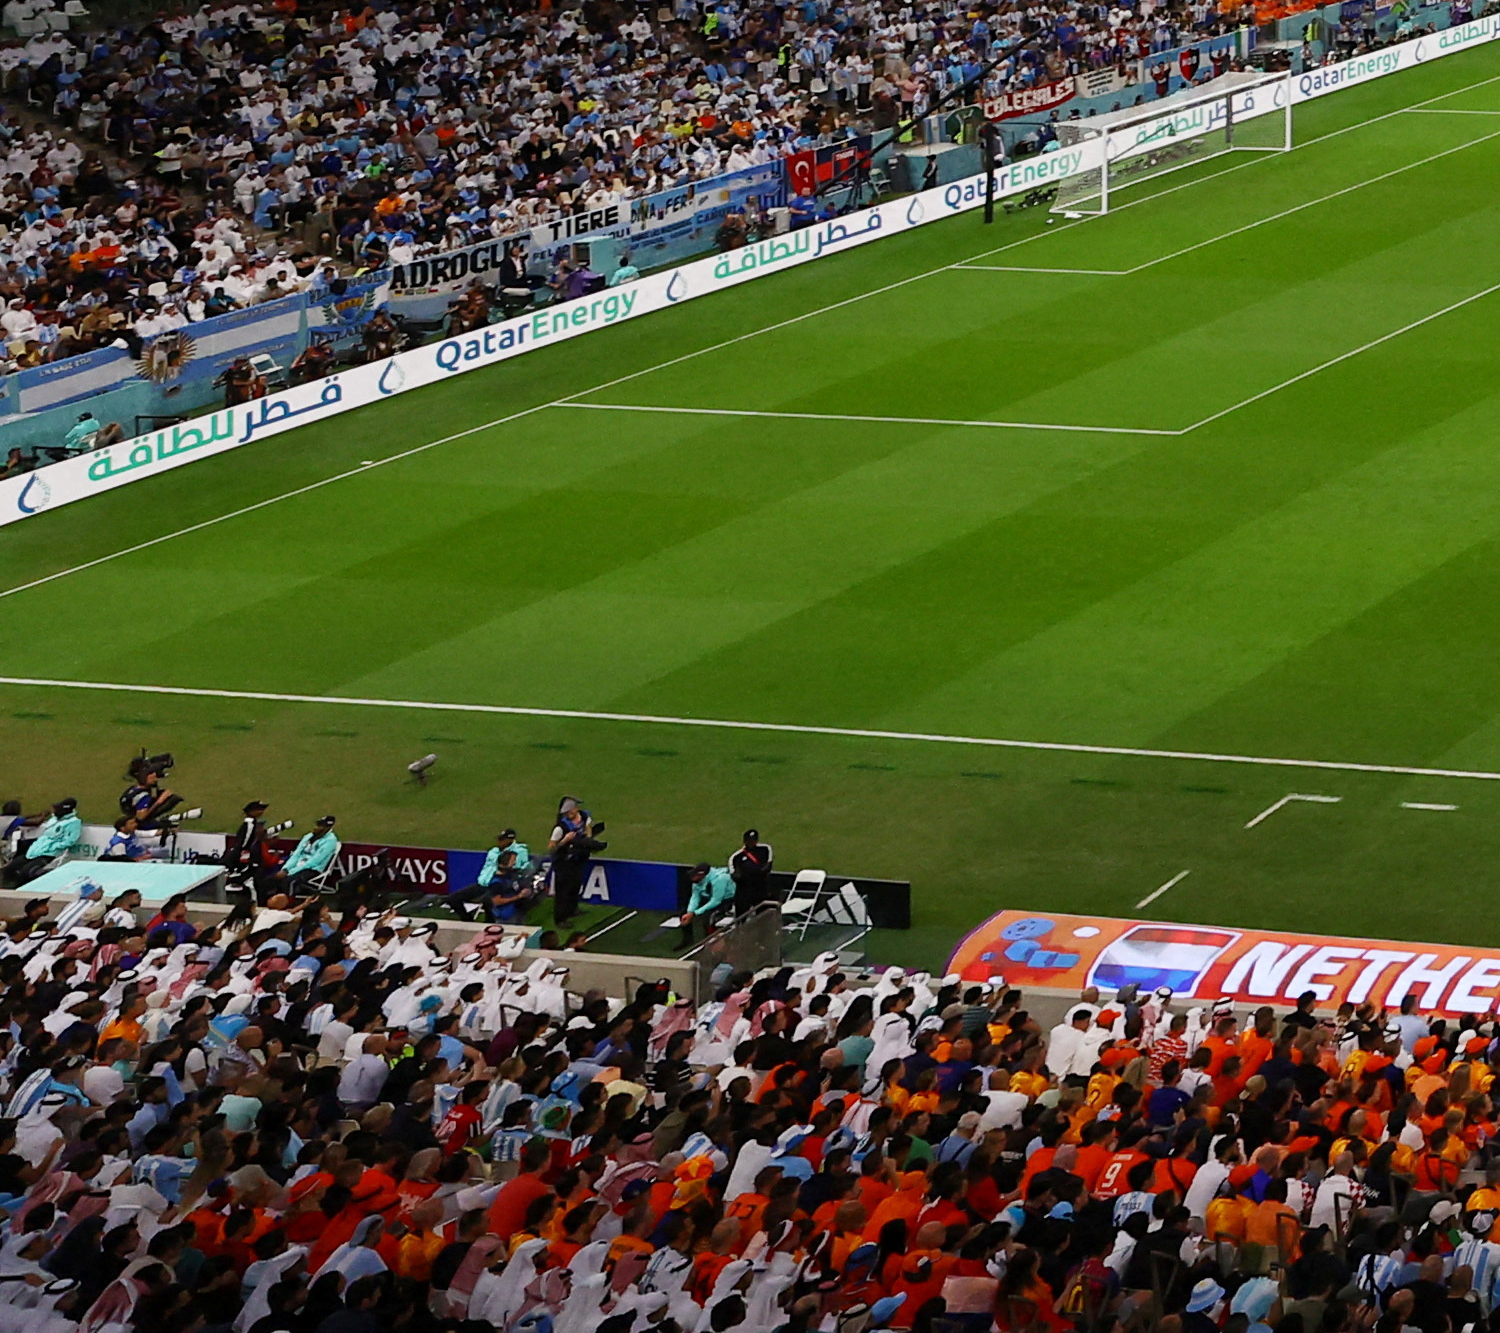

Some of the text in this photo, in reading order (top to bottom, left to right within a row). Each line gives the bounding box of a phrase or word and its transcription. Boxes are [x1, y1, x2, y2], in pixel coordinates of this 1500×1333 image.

[1439, 16, 1489, 48] للطاقة
[1300, 52, 1399, 96] QatarEnergy
[548, 205, 620, 241] TIGRE
[813, 208, 881, 257] قطر
[714, 230, 809, 279] للطاقة
[436, 290, 637, 372] QatarEnergy
[88, 376, 342, 481] قطر للطاقة
[1102, 1162, 1123, 1189] 9
